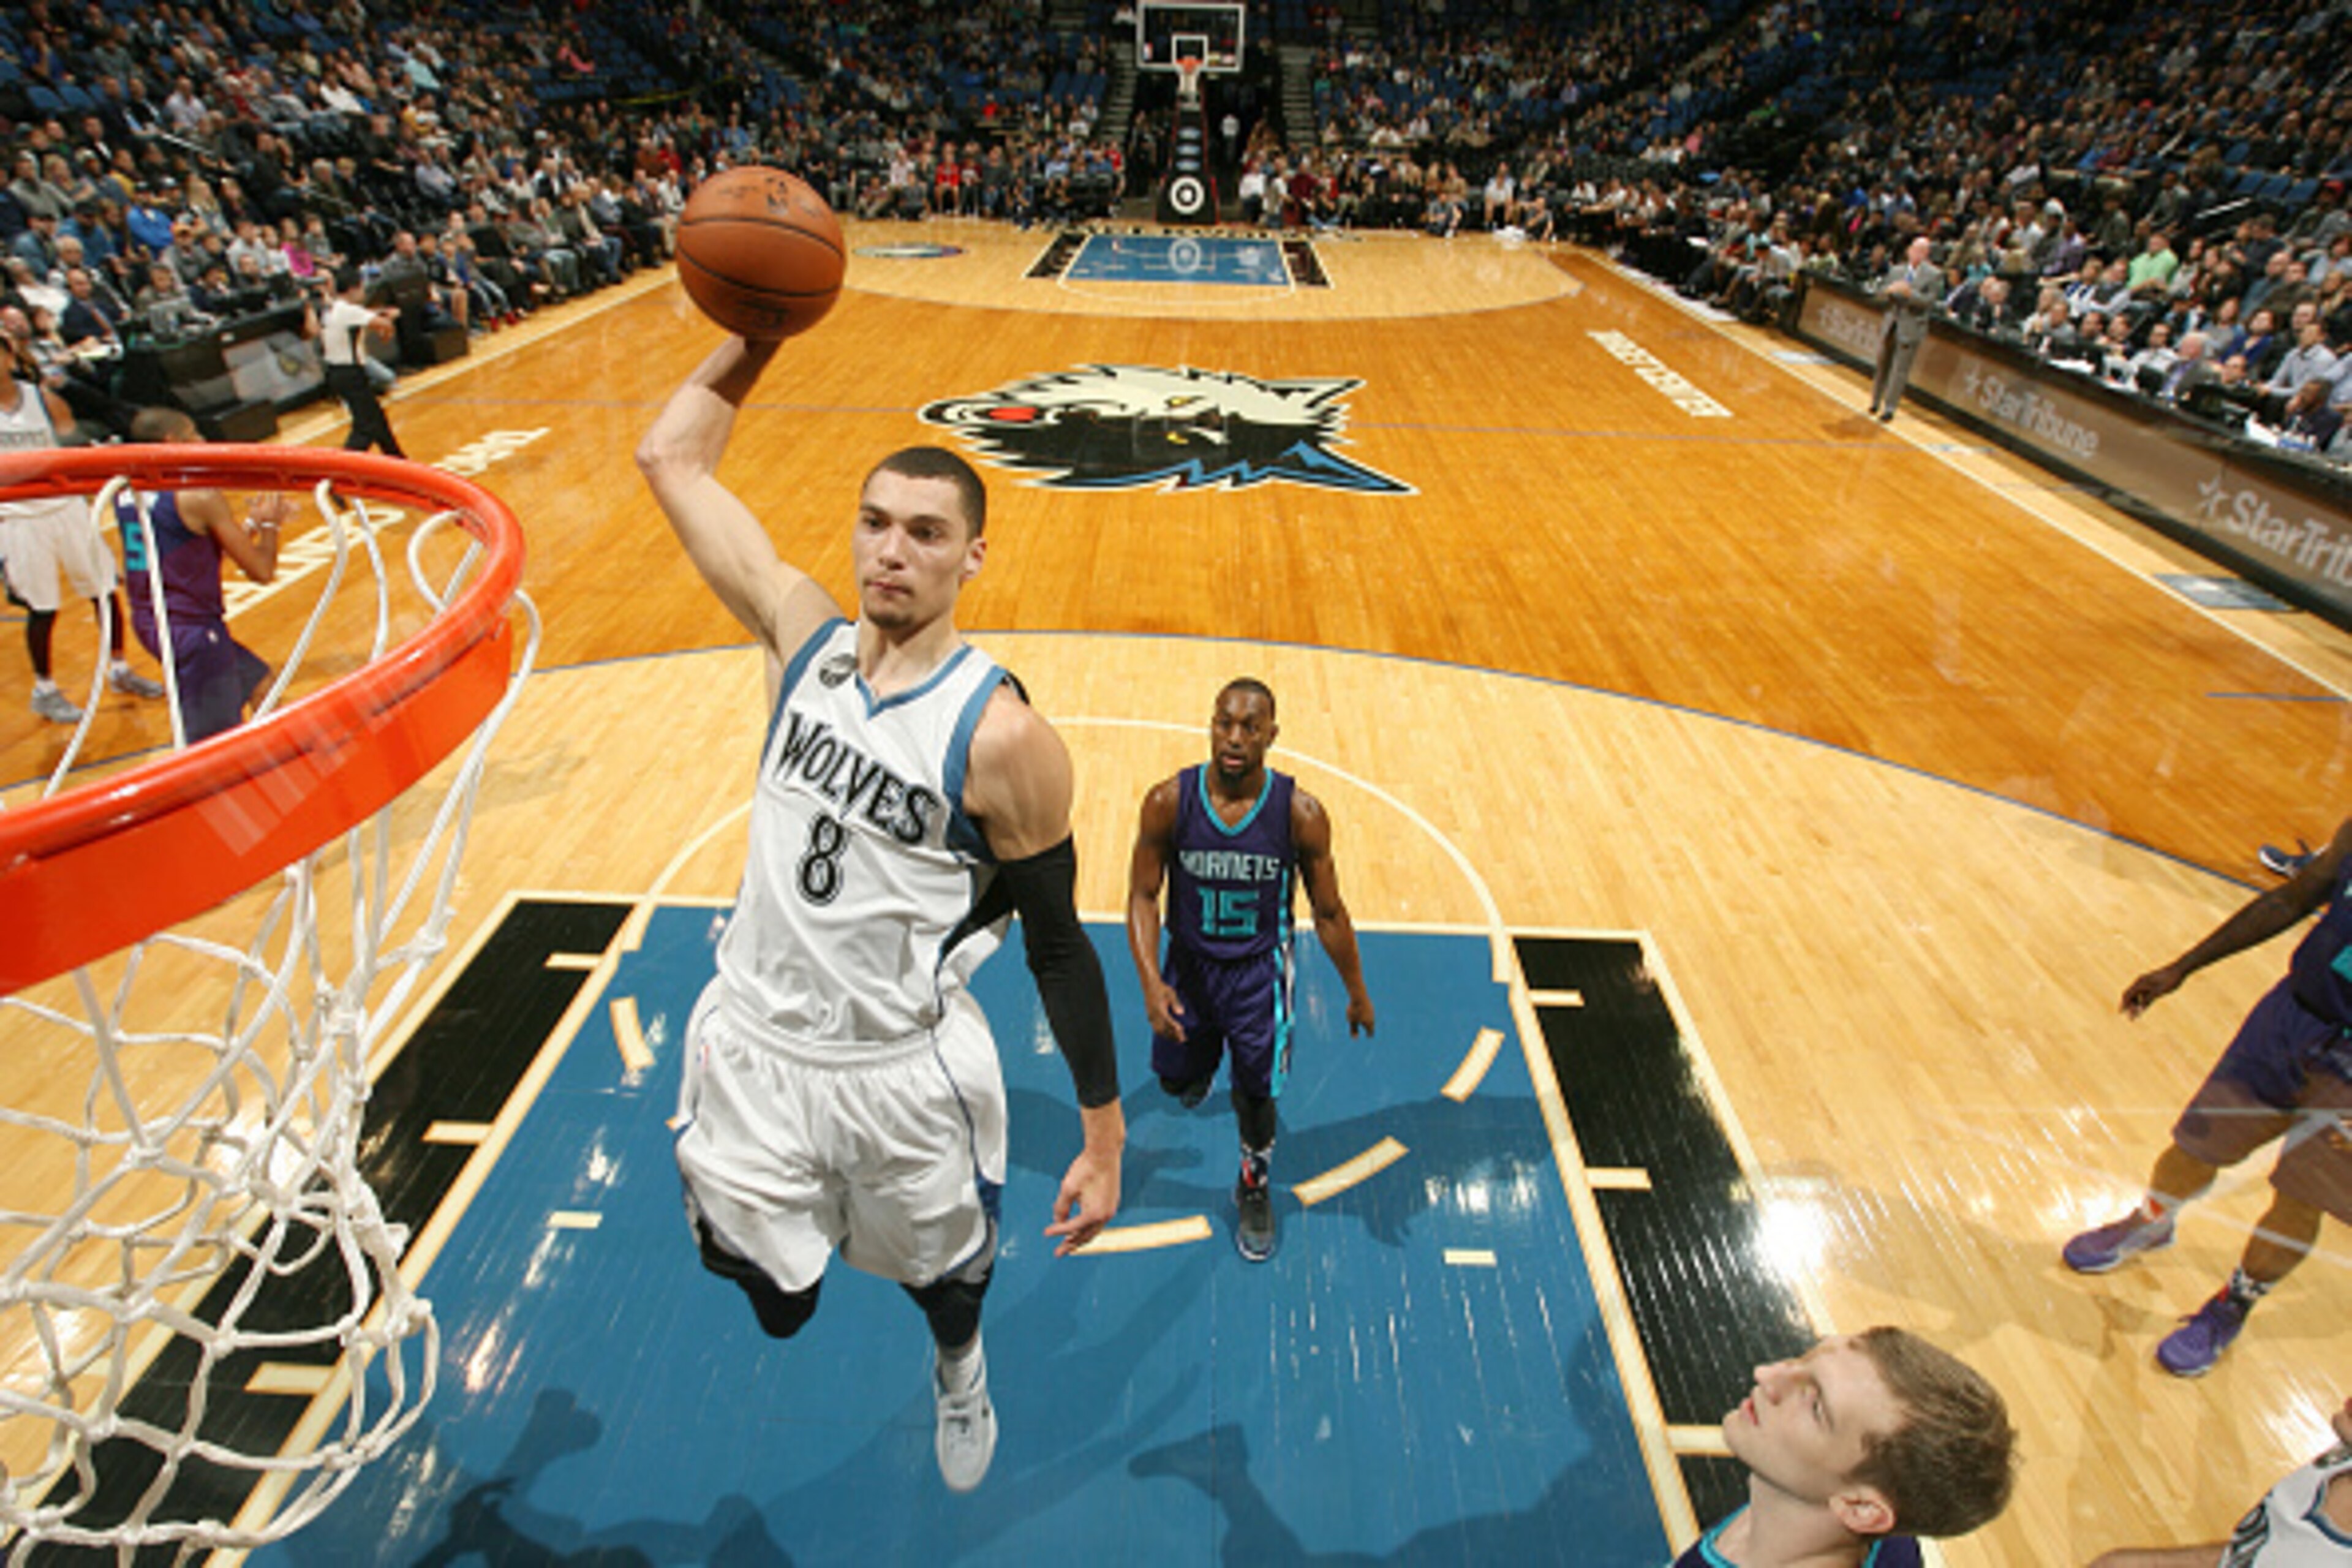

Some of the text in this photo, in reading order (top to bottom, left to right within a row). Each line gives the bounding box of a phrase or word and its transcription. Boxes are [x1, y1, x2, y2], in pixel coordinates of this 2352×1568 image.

[774, 709, 940, 846] WOLVES
[797, 812, 850, 907] 8
[1198, 887, 1259, 936] 15
